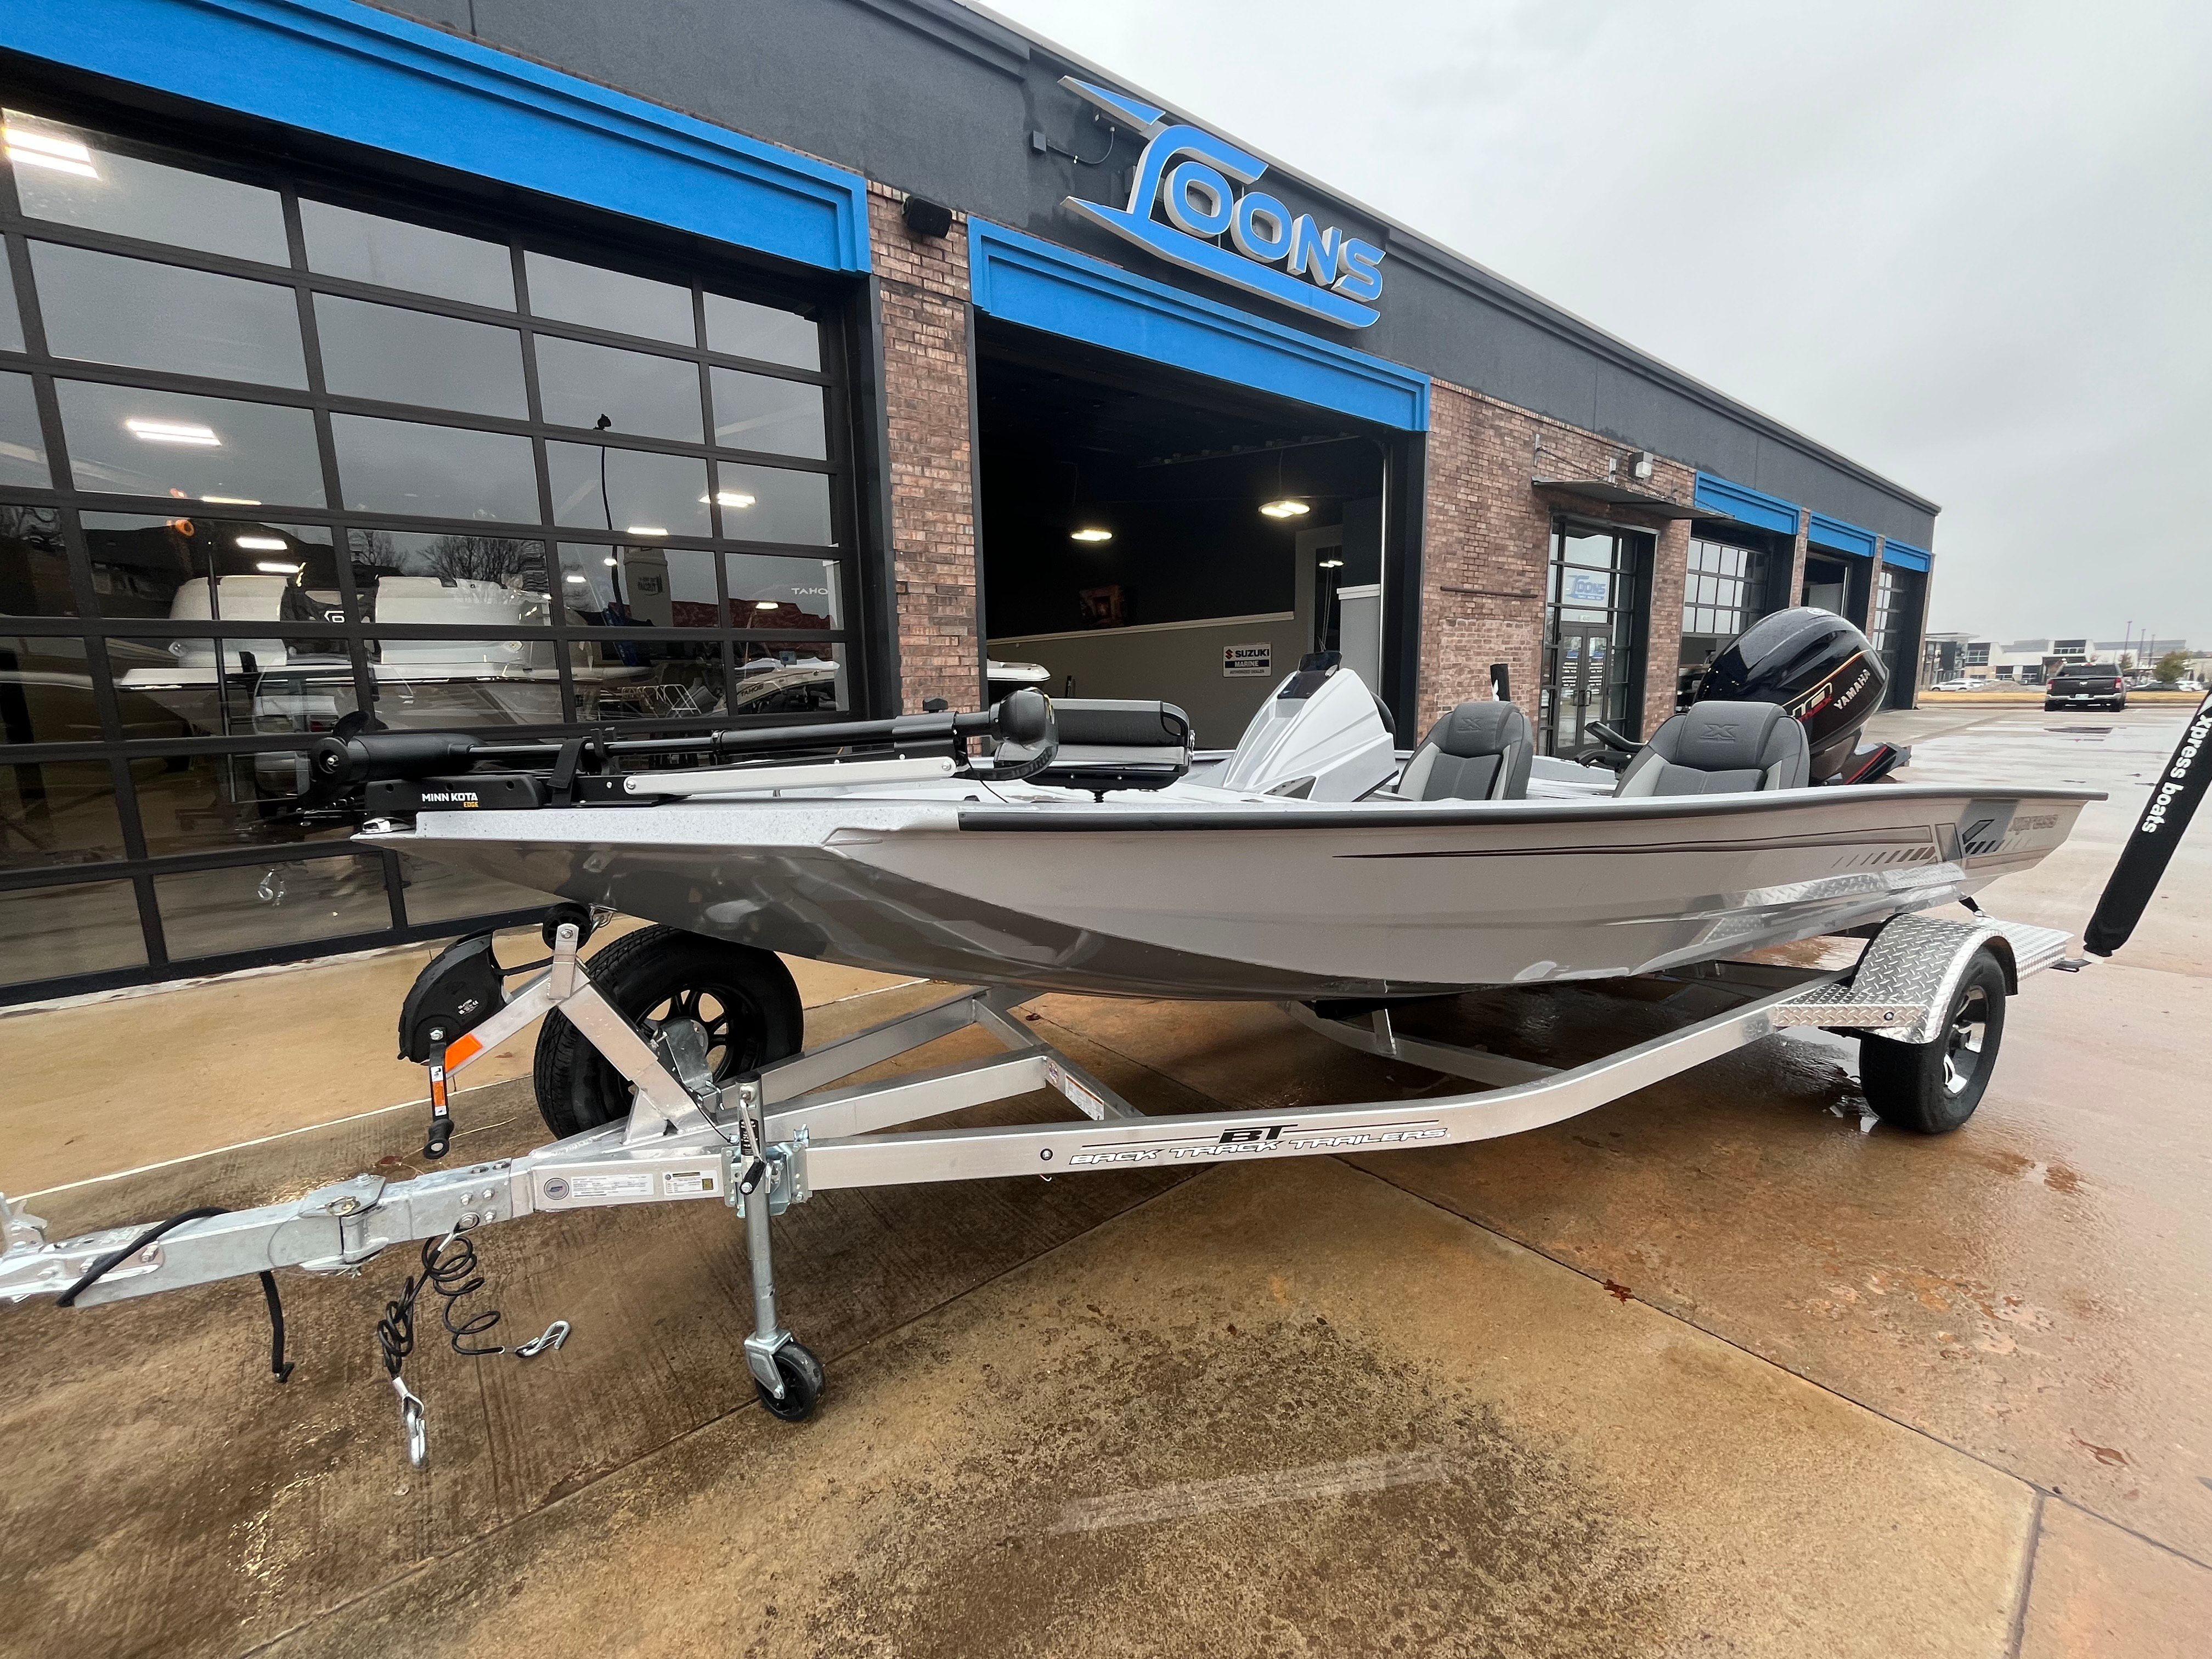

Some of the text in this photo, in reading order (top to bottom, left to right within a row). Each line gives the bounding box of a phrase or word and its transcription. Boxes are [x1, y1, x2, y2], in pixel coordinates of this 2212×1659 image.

[1057, 75, 1386, 329] LOONS
[1235, 648, 1269, 658] SUZUKI
[1833, 669, 1871, 710] YAMAHA
[2141, 714, 2212, 833] xpress boats
[421, 792, 478, 803] MINN KOTA
[1069, 1127, 1448, 1165] BACK TRACK TRAILERS
[1219, 1124, 1298, 1143] BT
